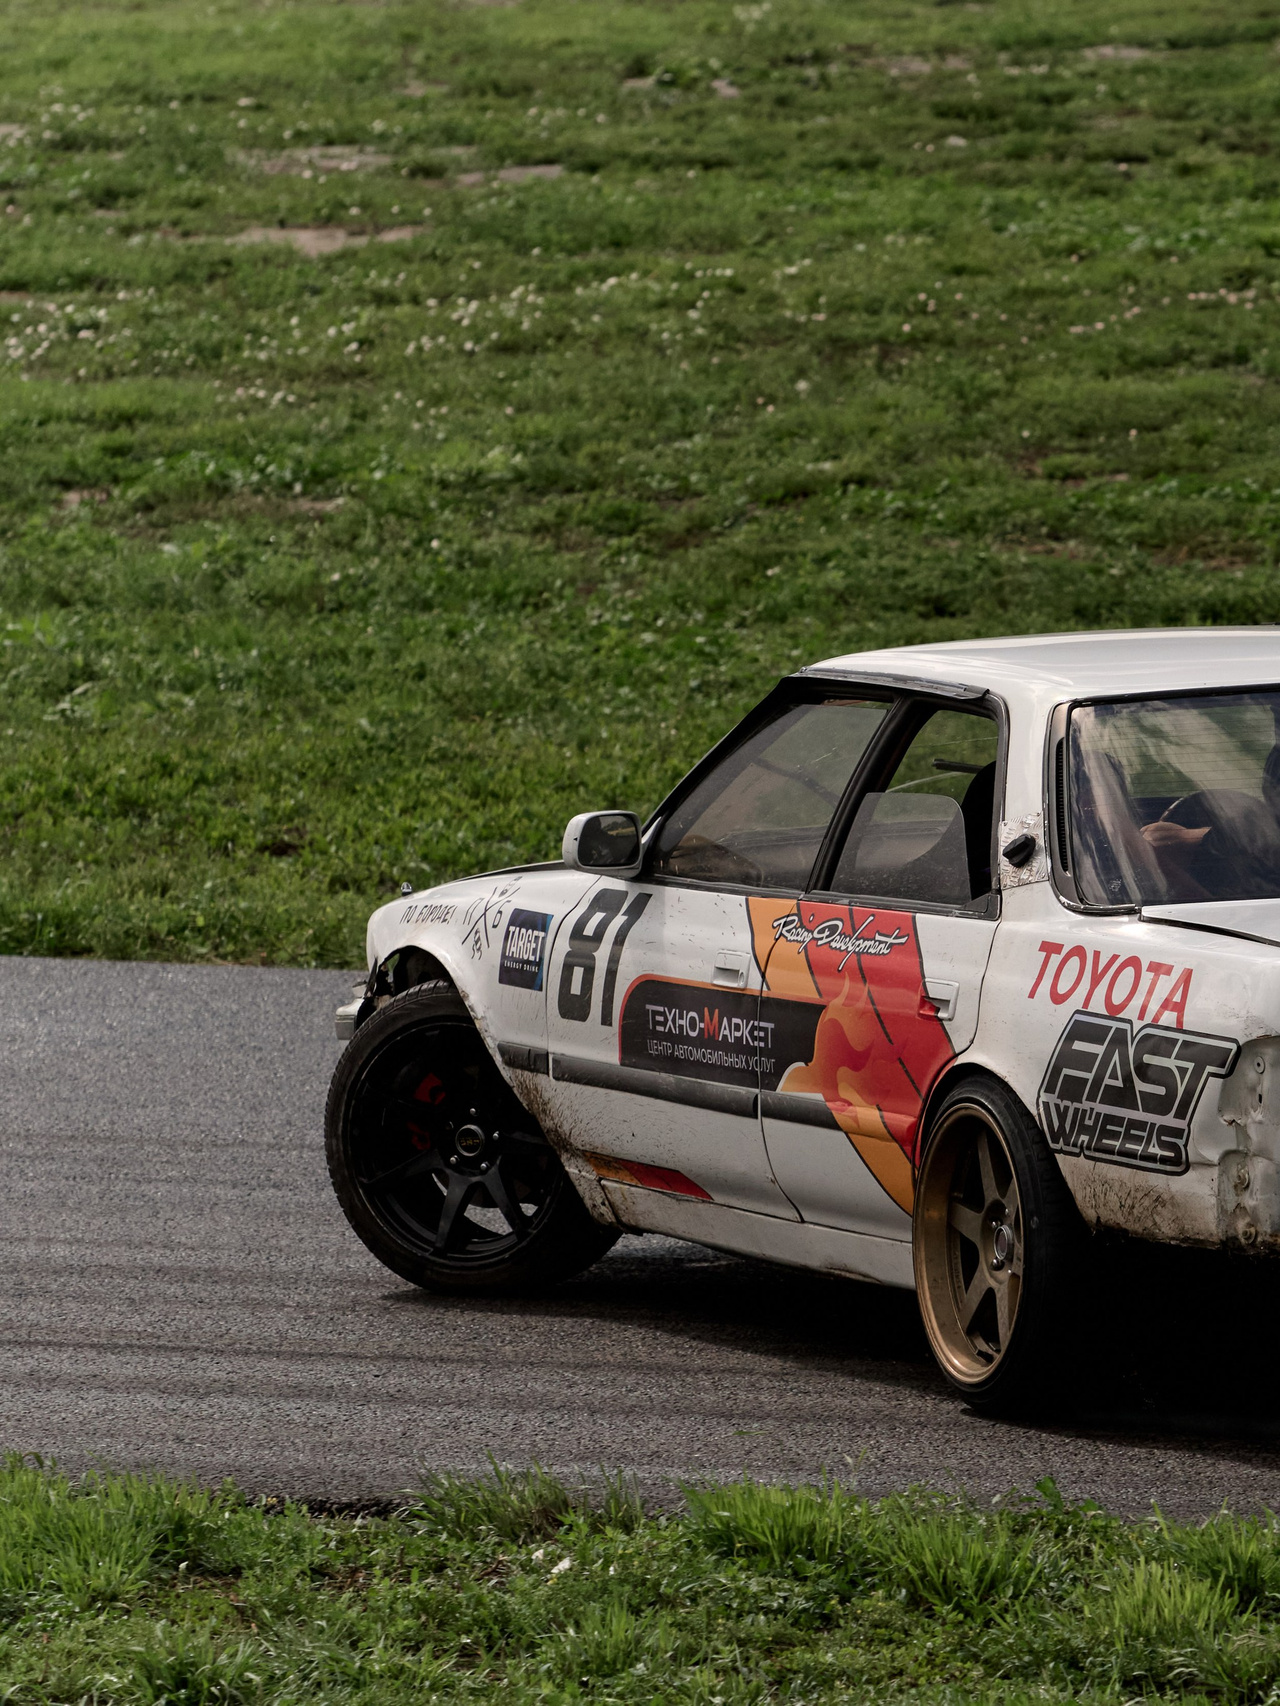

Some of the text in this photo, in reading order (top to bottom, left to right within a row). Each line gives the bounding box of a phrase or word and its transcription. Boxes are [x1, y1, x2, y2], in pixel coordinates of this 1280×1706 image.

[400, 904, 458, 925] ПО БОРОДЕ!
[504, 960, 539, 973] ENERGY DRINK
[505, 925, 546, 963] TARGET
[557, 888, 653, 1027] 81
[1027, 940, 1194, 1030] TOYOTA
[647, 1039, 775, 1073] ЦЕНТР АВТОМОБИЛЬНЫХ УСЛУГ
[1042, 1014, 1238, 1121] FAST
[1043, 1099, 1187, 1168] WHEELS
